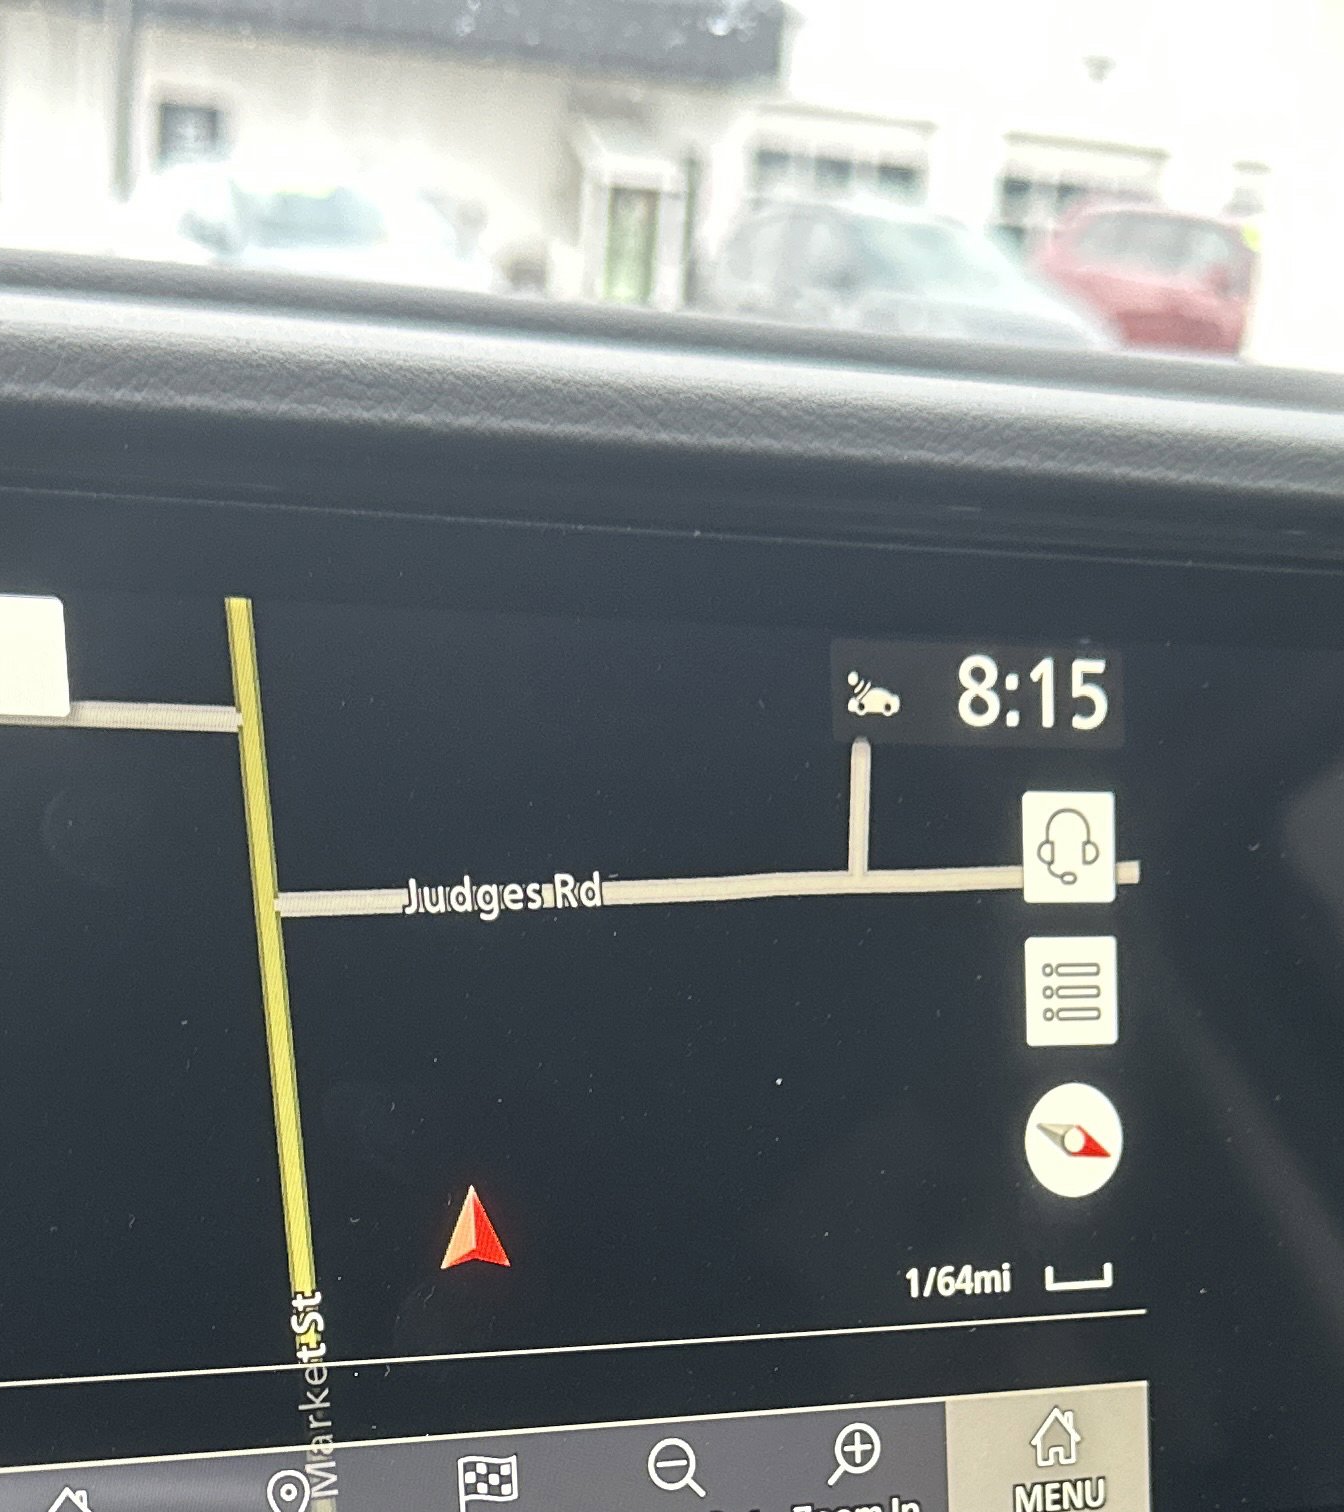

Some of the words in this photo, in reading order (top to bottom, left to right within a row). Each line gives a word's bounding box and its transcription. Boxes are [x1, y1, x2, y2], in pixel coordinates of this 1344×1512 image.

[956, 652, 1110, 731] 8:15
[402, 874, 543, 922] Judges
[554, 869, 604, 911] Rd
[905, 1263, 1011, 1298] 1/64mi
[290, 1290, 325, 1334] St
[296, 1342, 339, 1498] Market
